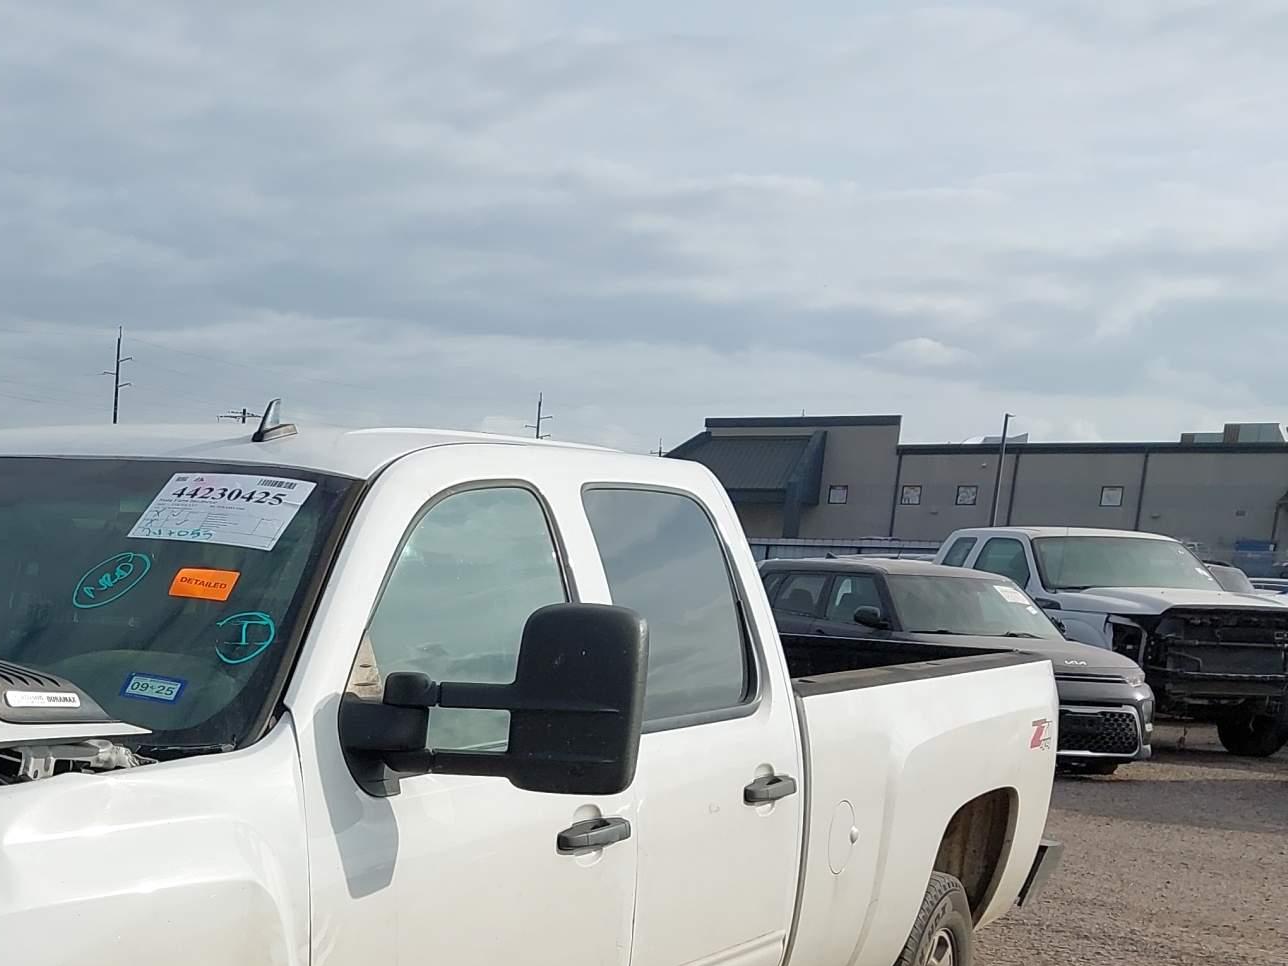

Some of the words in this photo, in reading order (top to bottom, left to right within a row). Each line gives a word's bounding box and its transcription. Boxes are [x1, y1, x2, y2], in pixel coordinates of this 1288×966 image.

[172, 486, 287, 506] 44230425
[179, 576, 227, 590] DETAILED
[130, 681, 149, 692] 09
[155, 685, 176, 697] 25
